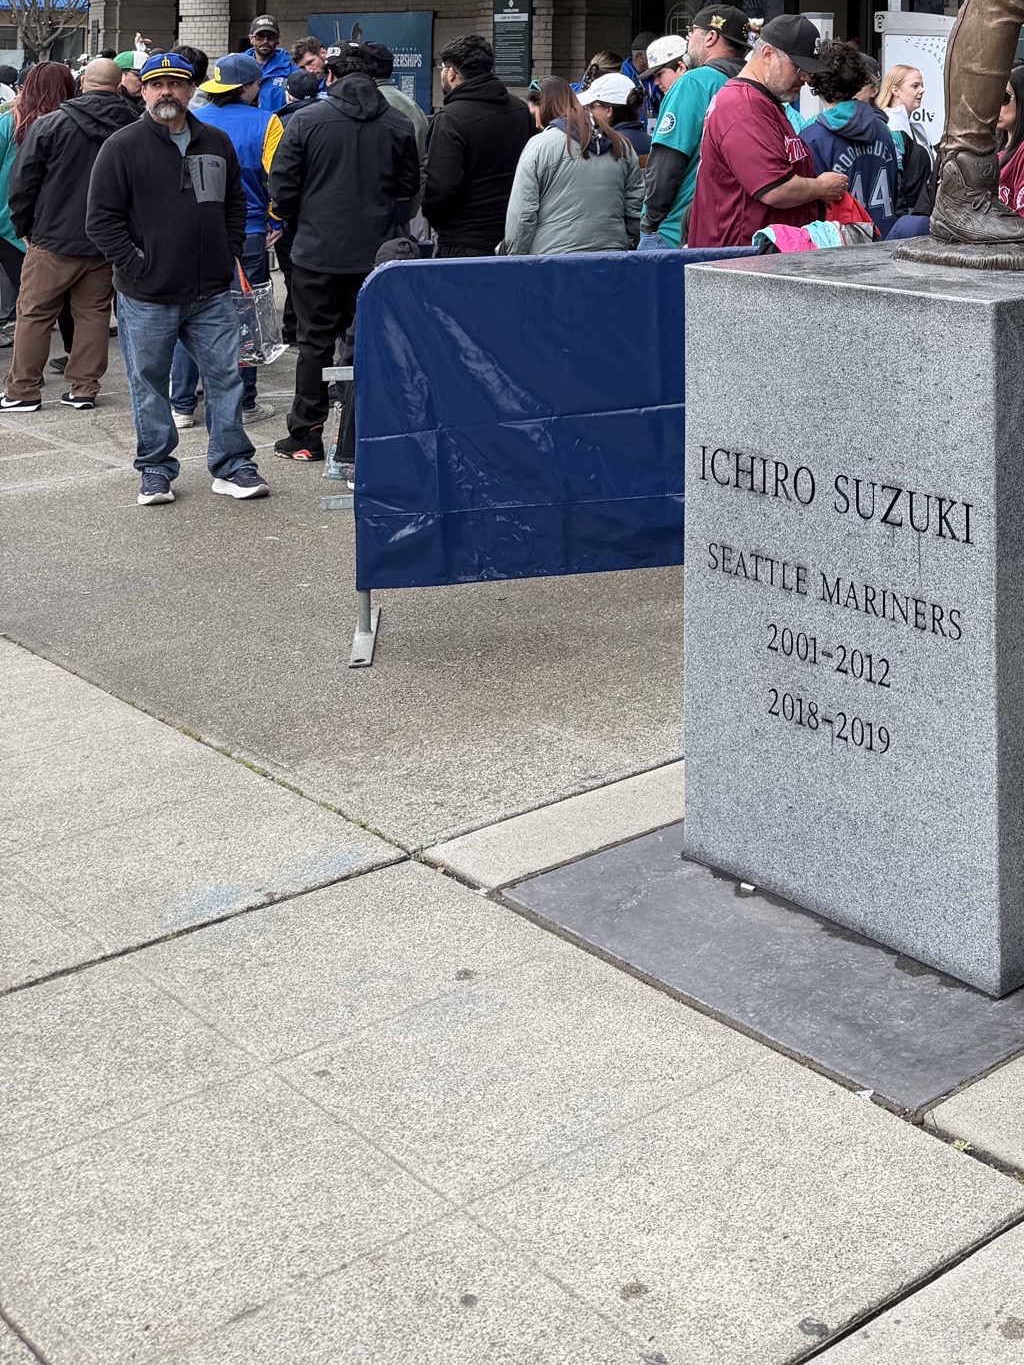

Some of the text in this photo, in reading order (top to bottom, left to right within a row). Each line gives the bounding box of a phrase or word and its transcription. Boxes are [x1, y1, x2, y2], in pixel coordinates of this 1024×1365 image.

[393, 53, 422, 68] BERSHIPS
[700, 445, 975, 545] ICHIRO SUZUKI
[708, 542, 962, 641] SEATTLE MARINERS
[767, 623, 891, 688] 2001-2012
[768, 688, 891, 754] 2018-2019
